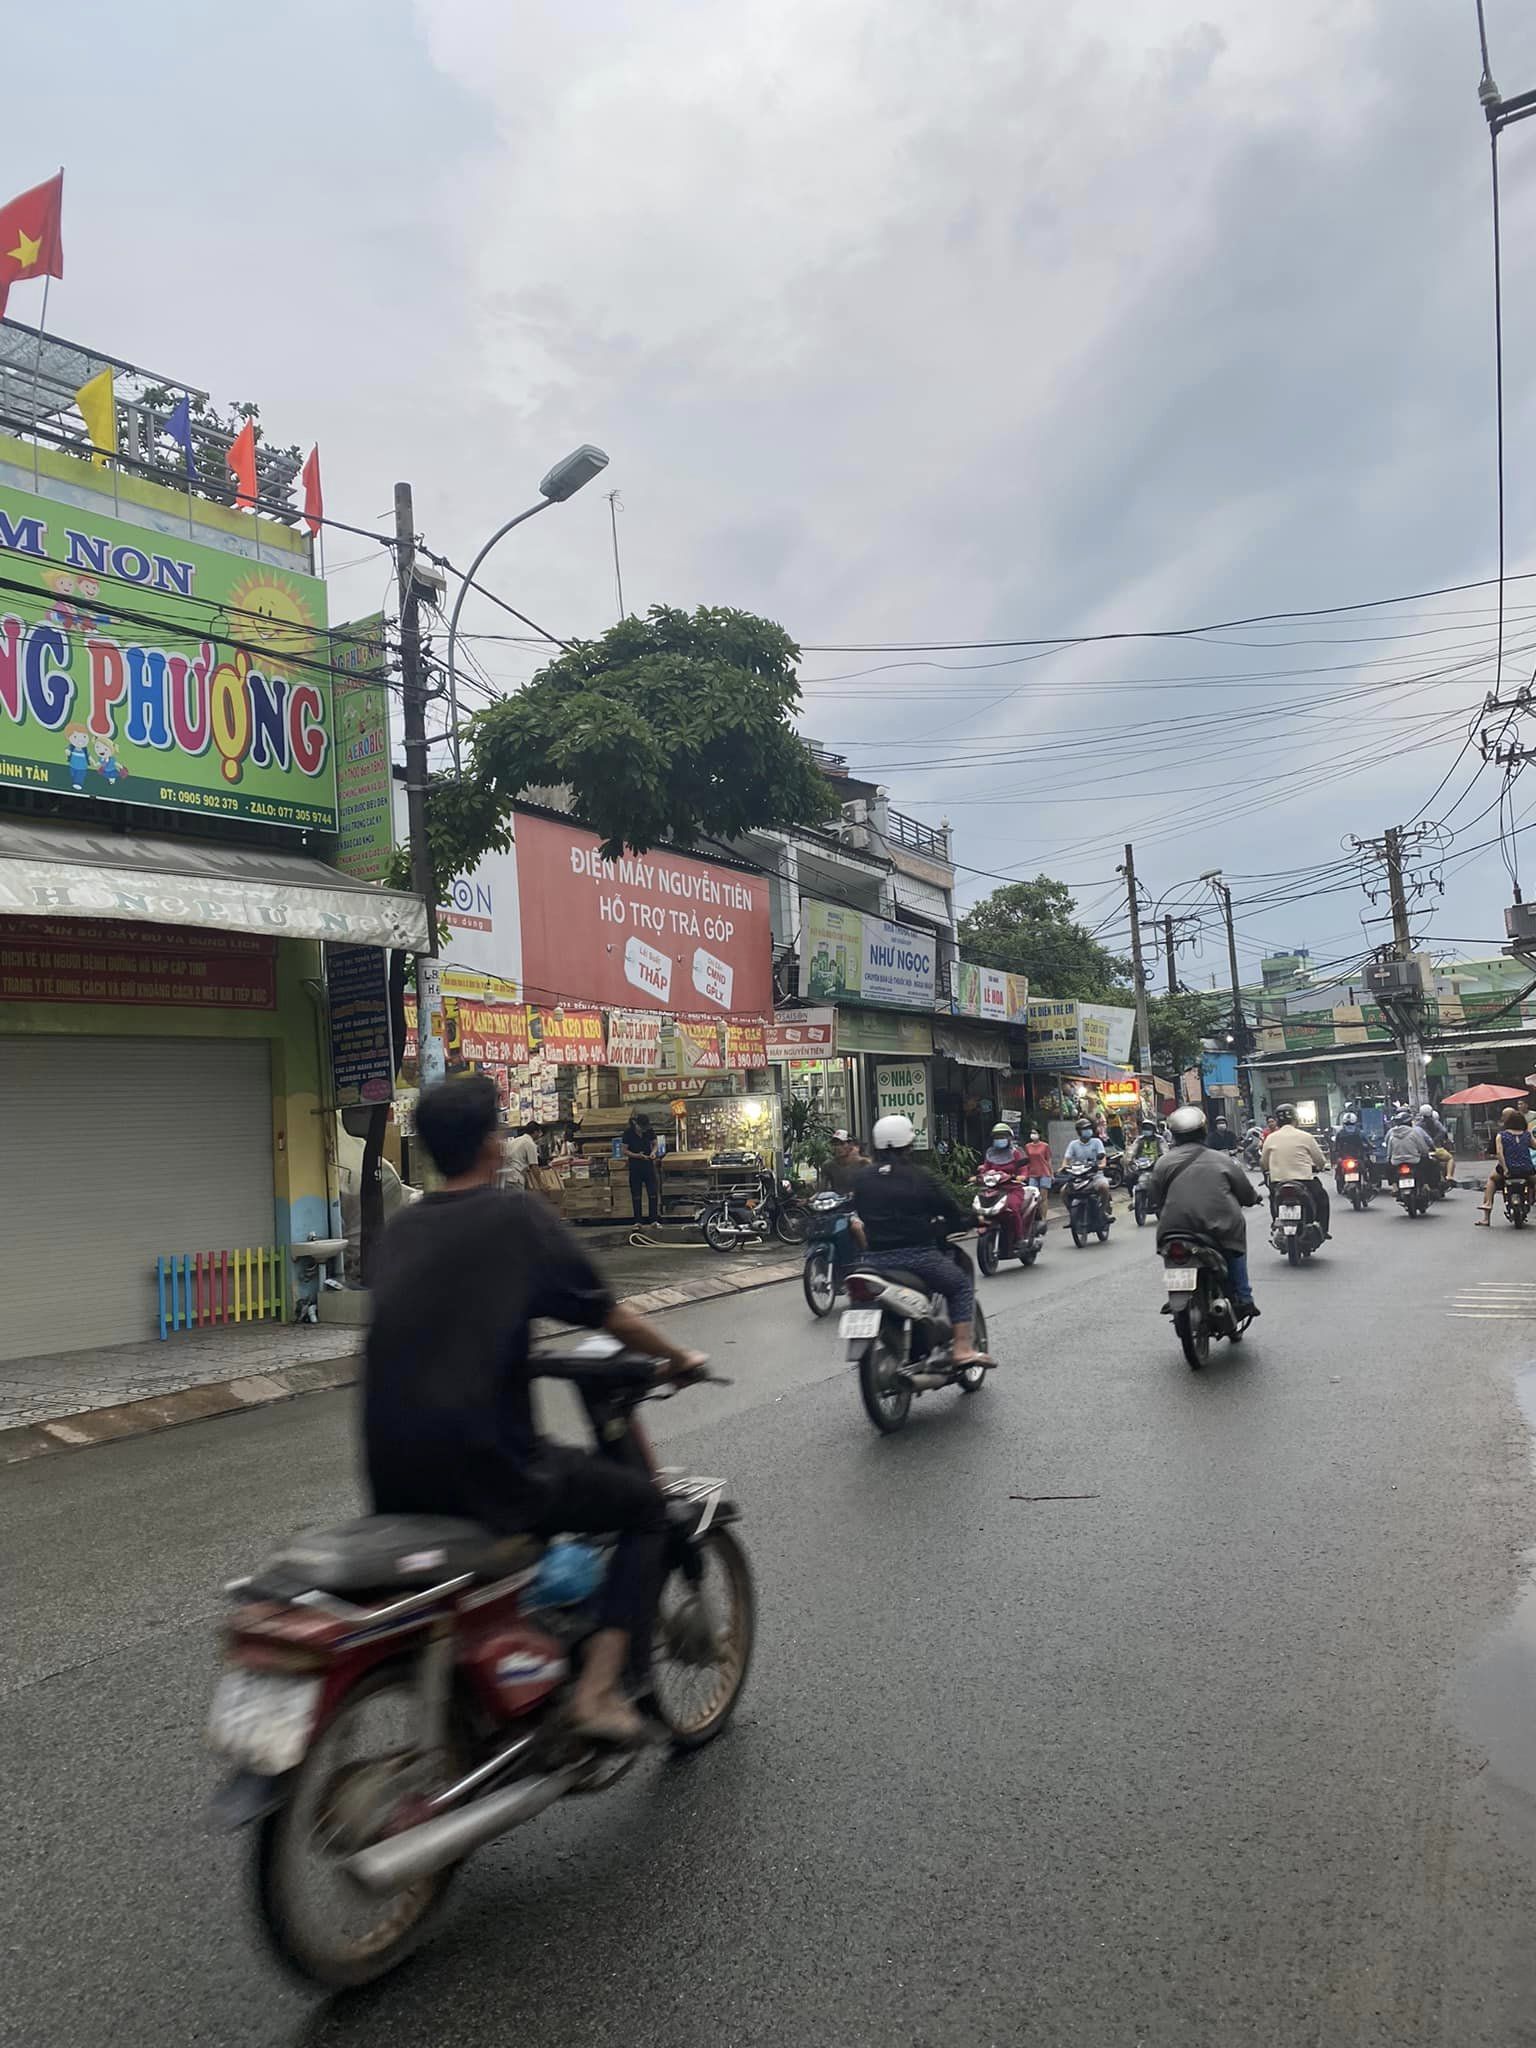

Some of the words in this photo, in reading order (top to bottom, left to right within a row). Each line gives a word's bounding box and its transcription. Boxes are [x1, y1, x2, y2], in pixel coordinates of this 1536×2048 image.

[65, 529, 194, 595] NON
[87, 639, 327, 780] PHƯỢNG
[347, 728, 384, 760] AEROBIC
[0, 759, 23, 778] ÌNH
[25, 764, 48, 782] TÂN
[160, 787, 176, 801] ĐT:
[178, 792, 201, 804] 0905
[203, 794, 220, 809] 902
[222, 798, 239, 810] 379
[250, 802, 277, 816] ZALO:
[278, 807, 293, 819] 077
[295, 809, 311, 822] 305
[312, 811, 332, 825] 9744
[570, 846, 614, 885] ĐIỆN
[619, 858, 654, 889] MÁY
[659, 870, 720, 905] NGUYỄN
[722, 882, 753, 912] TIÊN
[599, 893, 626, 924] HỖ
[630, 902, 665, 936] TRỢ
[669, 909, 701, 937] TRẢ
[704, 914, 734, 942] GÓP
[638, 961, 668, 991] THẤP
[706, 965, 726, 985] CMND
[870, 943, 895, 967] NHƯ
[897, 949, 930, 978] NGỌC
[706, 984, 725, 1001] GPLX
[891, 1066, 912, 1087] NHÀ
[880, 1088, 924, 1107] THUỐC
